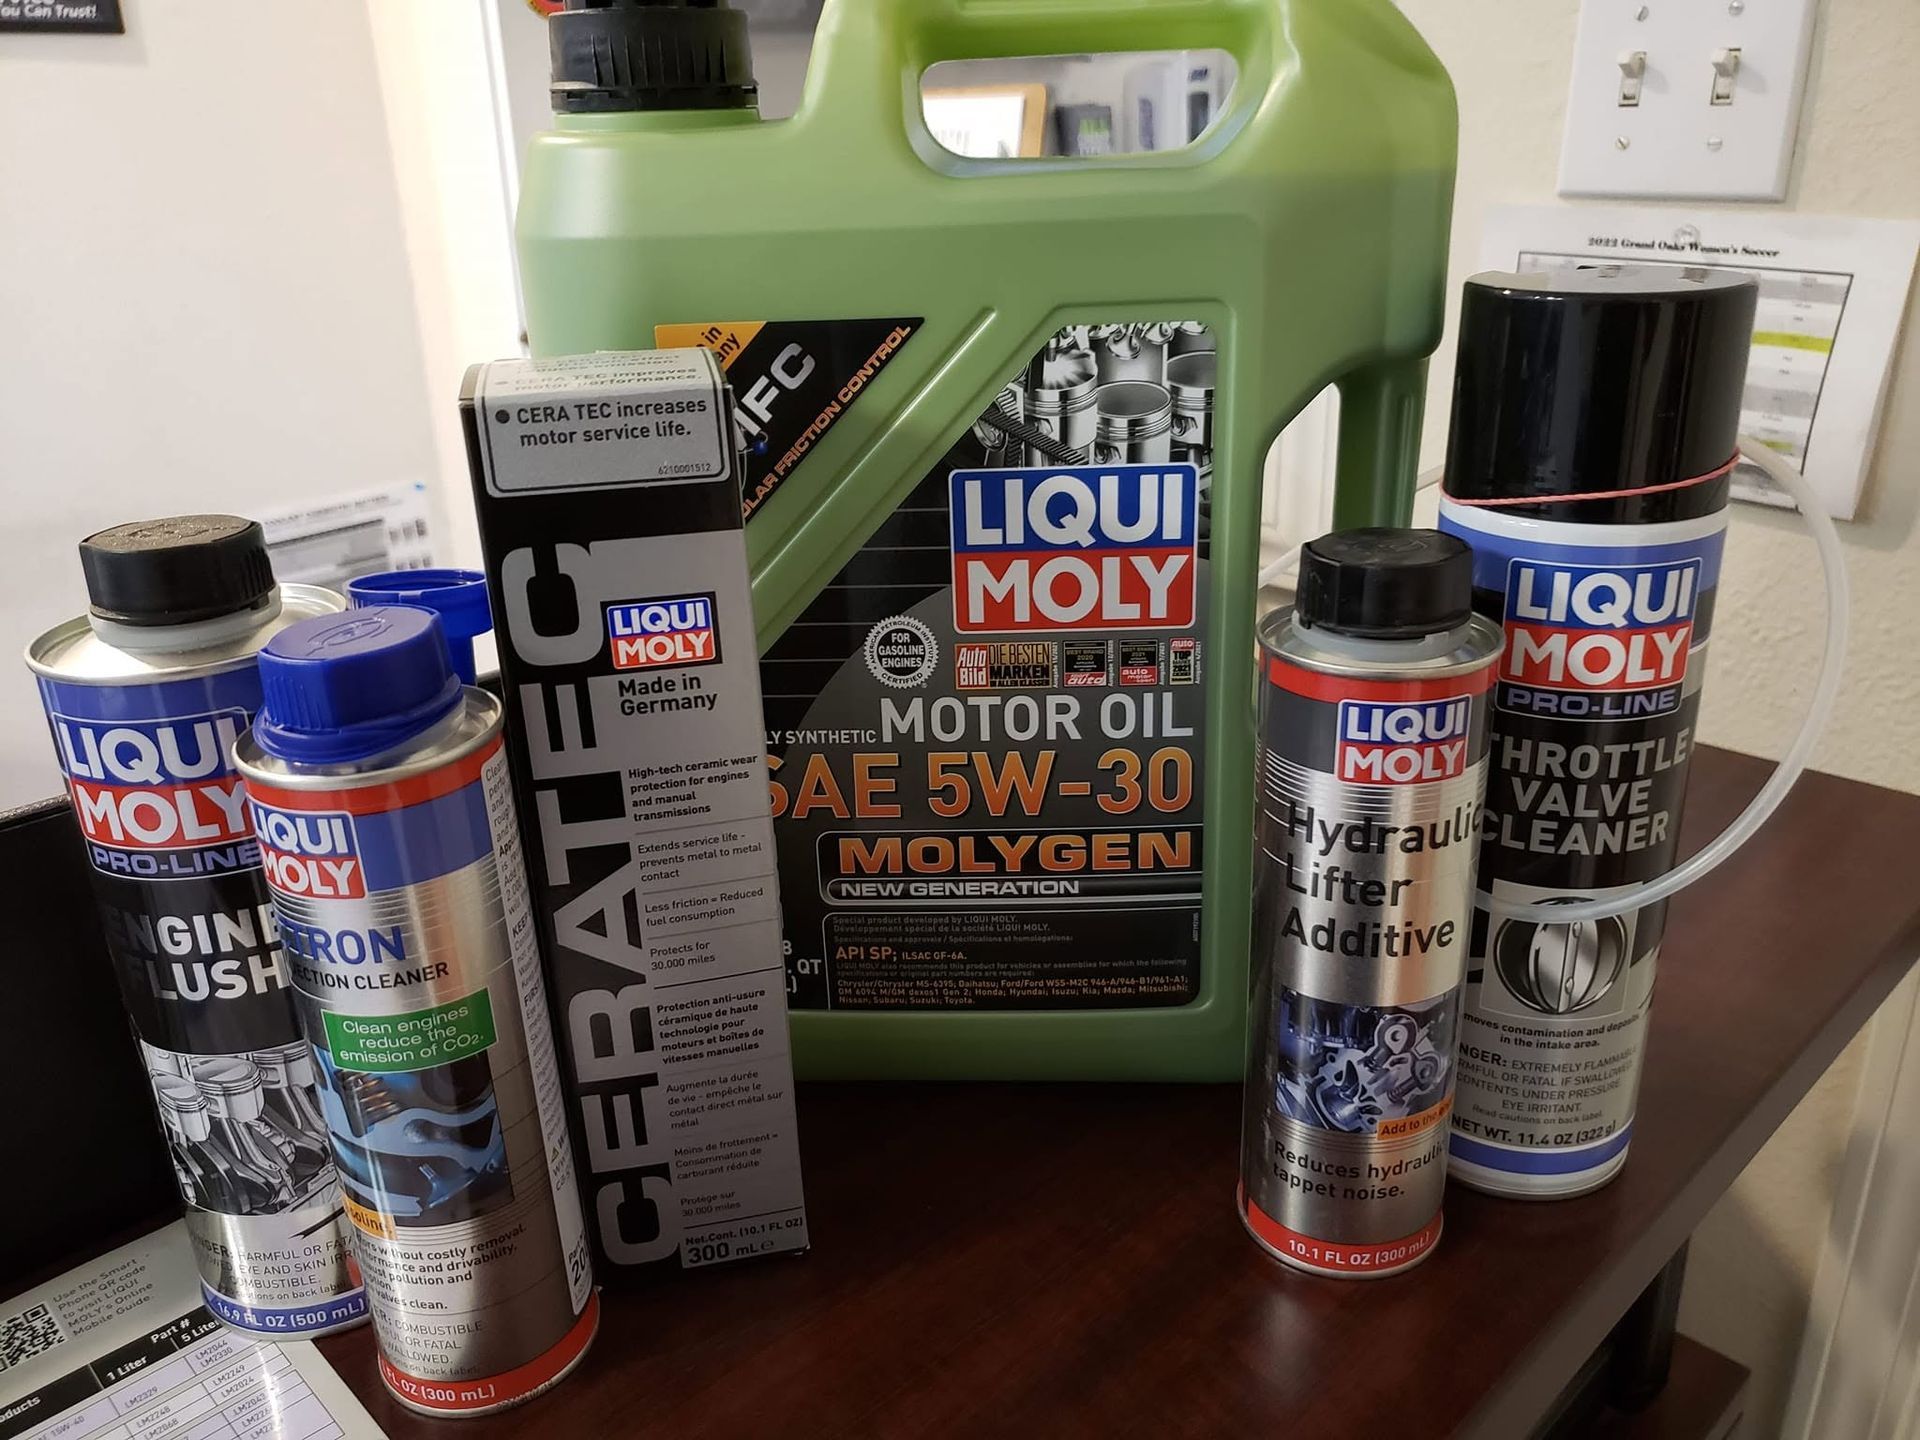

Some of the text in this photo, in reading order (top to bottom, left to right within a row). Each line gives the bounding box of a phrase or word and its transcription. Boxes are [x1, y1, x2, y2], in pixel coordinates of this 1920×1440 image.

[0, 4, 97, 19] ou Can Trust!
[1621, 238, 1655, 249] Grand
[1742, 246, 1780, 257] Soccer
[517, 399, 707, 425] CERA TEC increases
[774, 324, 911, 476] FRICTION CONTROL
[520, 421, 692, 447] motor service life.
[658, 463, 712, 475] 6210001512
[965, 473, 1182, 548] LIQUI
[967, 554, 1189, 624] MOLY
[1516, 566, 1695, 628] LIQUI
[612, 601, 706, 637] LIQUI
[617, 631, 709, 665] MOLY
[878, 645, 925, 656] GASOLINE
[891, 632, 911, 643] FOR
[881, 657, 922, 668] ENGINES
[957, 647, 987, 667] Auto
[988, 644, 1006, 666] DIE
[1009, 643, 1050, 666] BESTEN
[1509, 626, 1689, 686] MOLY
[617, 673, 701, 698] Made in
[960, 667, 987, 686] Bild
[990, 665, 1050, 679] MARKEN
[1067, 674, 1105, 686] auto
[620, 692, 718, 717] Germany
[1507, 688, 1677, 716] PRO-LINE
[785, 692, 1194, 744] SYNTHETIC MOTOR OIL
[1346, 702, 1465, 744] LIQUI
[59, 718, 237, 785] LIQUI
[1344, 740, 1464, 782] MOLY
[1491, 727, 1690, 780] HROTTLE
[628, 753, 758, 780] High-tech ceramic wear
[630, 769, 750, 796] protection for engines
[926, 746, 1194, 817] 5W-30
[632, 790, 697, 809] and manual
[1511, 776, 1653, 818] VALVE
[76, 781, 250, 843] MOLY
[634, 803, 712, 823] transmissions
[256, 807, 348, 854] LIQUI
[1288, 801, 1482, 856] Hydraulic
[1481, 811, 1669, 856] CLEANER
[638, 832, 738, 855] Extends service life
[639, 842, 762, 870] prevents metal to metal
[838, 831, 1192, 874] MOLYGEN
[93, 844, 265, 874] PRO-LINE
[263, 842, 356, 897] MOLY
[641, 869, 680, 882] contact
[841, 880, 1080, 898] NEW GENERATION
[1286, 852, 1413, 907] Lifter
[501, 543, 682, 1266] CERATEC
[645, 887, 763, 914] Less friction Reduced
[646, 906, 735, 927] fuel consumption
[1281, 906, 1455, 958] Additive
[650, 942, 711, 958] Protects for
[651, 953, 716, 971] 30.000 miles
[836, 946, 864, 960] API
[869, 946, 897, 961] SP;
[902, 952, 931, 960] ILSAC
[143, 950, 290, 1001] LUSH
[354, 962, 449, 990] CLEANER
[797, 959, 822, 974] QT
[343, 1006, 468, 1035] Clean engines
[1502, 1024, 1605, 1038] contamination and
[359, 1025, 456, 1050] reduce the
[1500, 1034, 1600, 1050] in the intake area.
[340, 1048, 415, 1063] emission
[420, 1043, 439, 1058] of
[1452, 1114, 1616, 1146] NET WT. 11.4 OZ (322 g)
[1275, 1141, 1360, 1178] Reduces
[1273, 1162, 1405, 1201] tappet noise.
[427, 1223, 527, 1262] costly removal.
[688, 1242, 757, 1265] 300 mL
[1288, 1232, 1430, 1265] 10.1 FL OZ (300 mL)
[100, 1259, 138, 1280] Smart
[419, 1243, 517, 1272] and drivability.
[58, 1290, 97, 1312] Phone
[104, 1278, 139, 1300] LIQUI
[68, 1283, 153, 1328] MOLY's Online
[218, 1302, 240, 1321] 16.9
[266, 1316, 287, 1327] OZ
[290, 1310, 327, 1327] (500
[332, 1298, 365, 1320] mL)
[73, 1314, 113, 1336] Mobile
[151, 1324, 178, 1346] Part
[106, 1355, 149, 1381] 1 Liter
[401, 1379, 496, 1402] OZ (300 mL)
